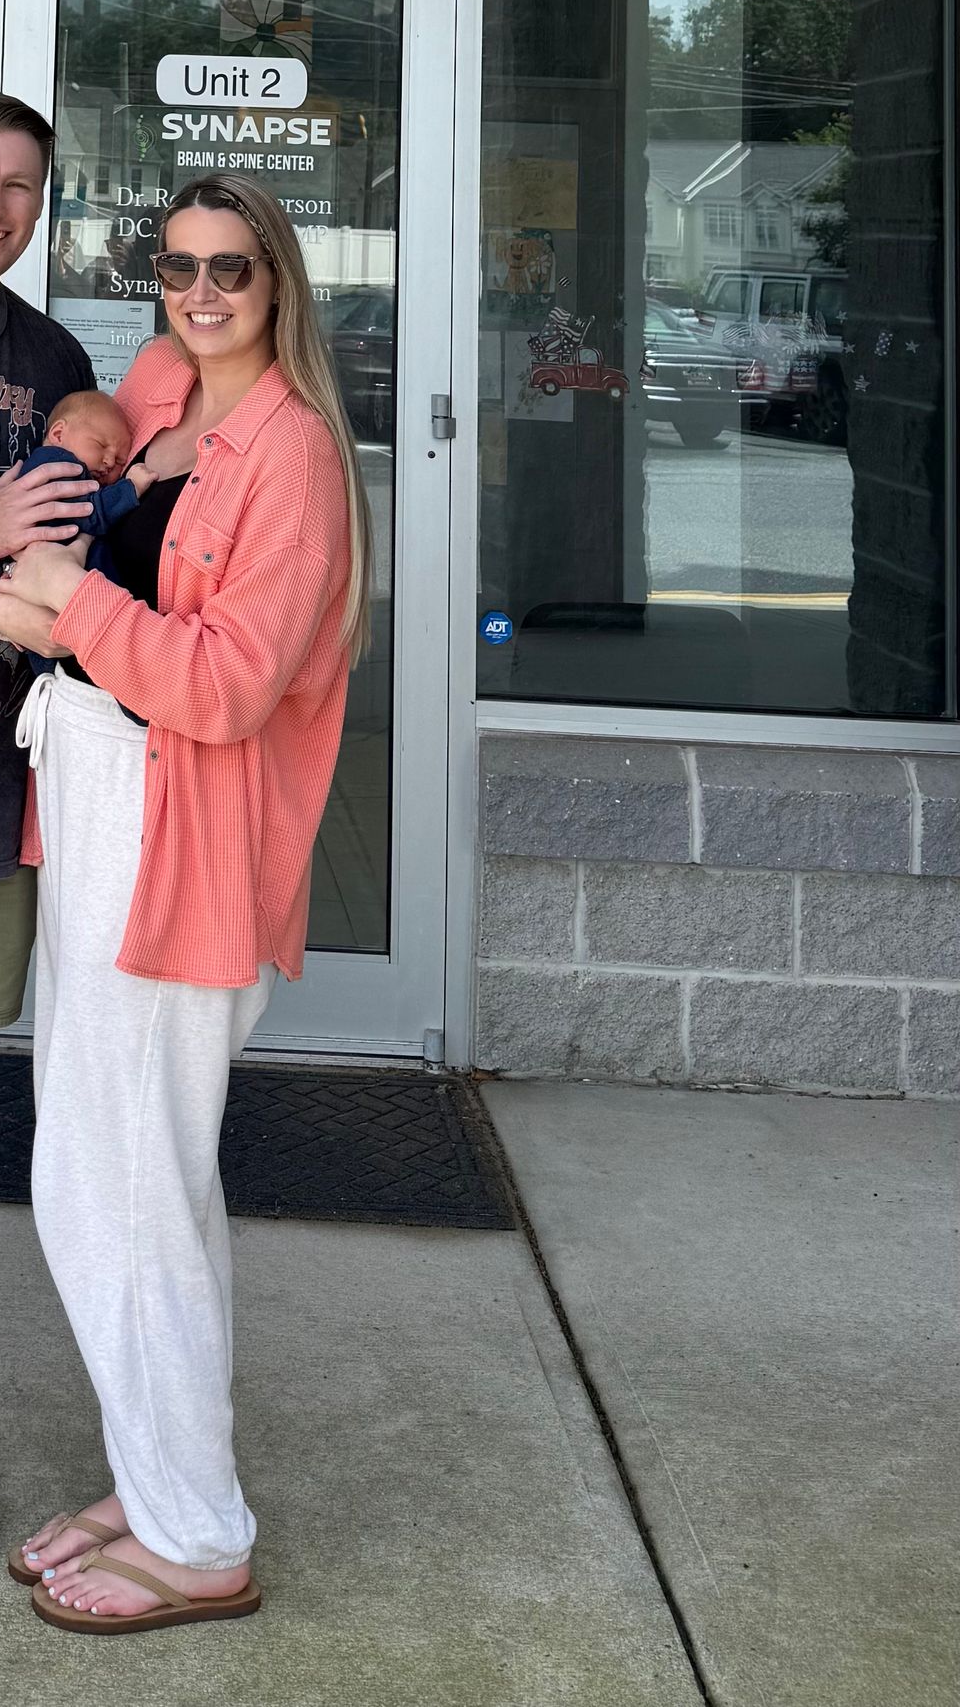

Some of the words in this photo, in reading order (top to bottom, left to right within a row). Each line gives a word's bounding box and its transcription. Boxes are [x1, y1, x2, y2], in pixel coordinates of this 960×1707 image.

[184, 65, 250, 97] Unit
[260, 68, 281, 98] 2
[161, 113, 332, 146] SYNAPSE
[177, 150, 215, 168] BRAIN
[217, 152, 226, 169] &
[229, 152, 265, 170] SPINE
[267, 154, 315, 172] CENTER
[115, 187, 148, 207] Dr.
[117, 217, 157, 239] DC.
[485, 620, 509, 634] ADT
